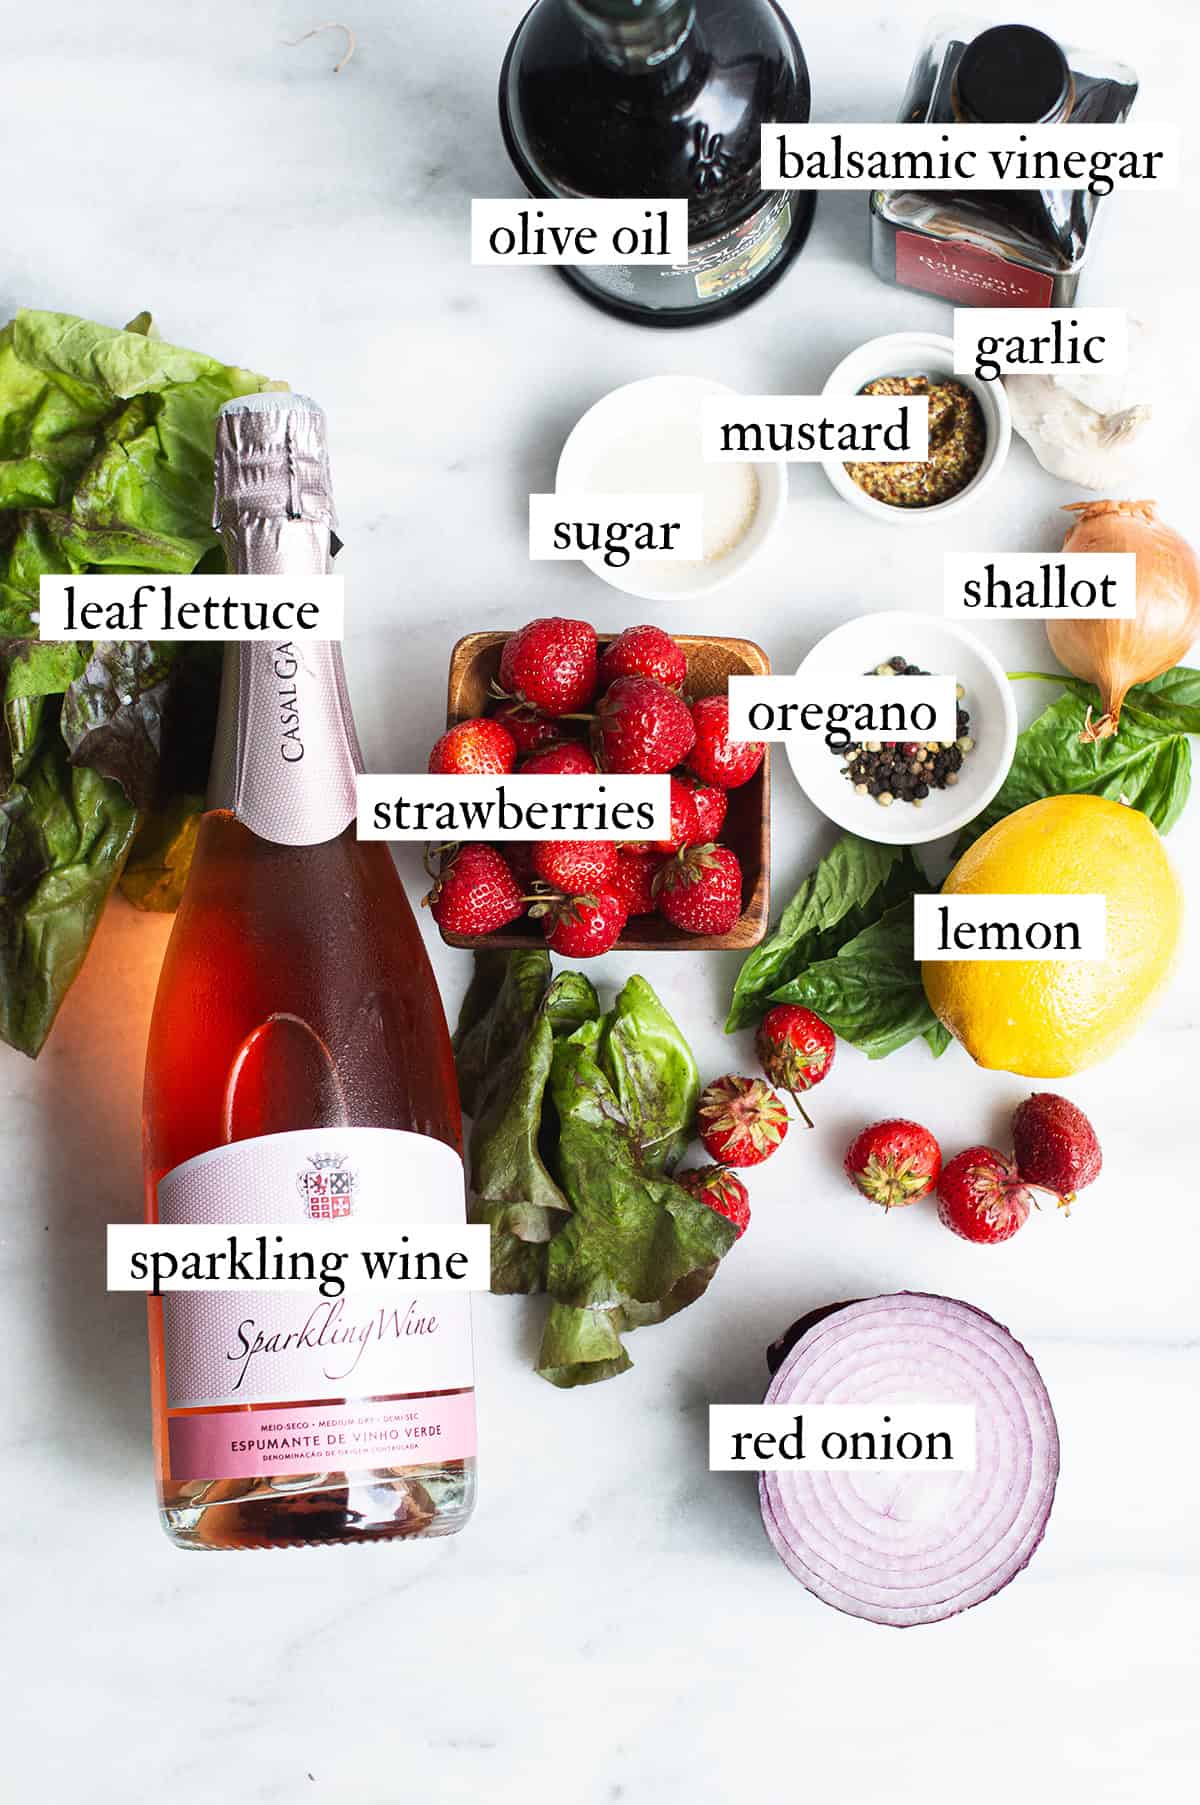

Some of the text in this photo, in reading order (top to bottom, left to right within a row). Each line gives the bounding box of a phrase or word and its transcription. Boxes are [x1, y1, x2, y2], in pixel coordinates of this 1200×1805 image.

[279, 683, 305, 763] CASAL
[227, 1298, 440, 1392] Sparkling Wine
[231, 1424, 441, 1452] ESPUMANTE DE VINHO VERDE
